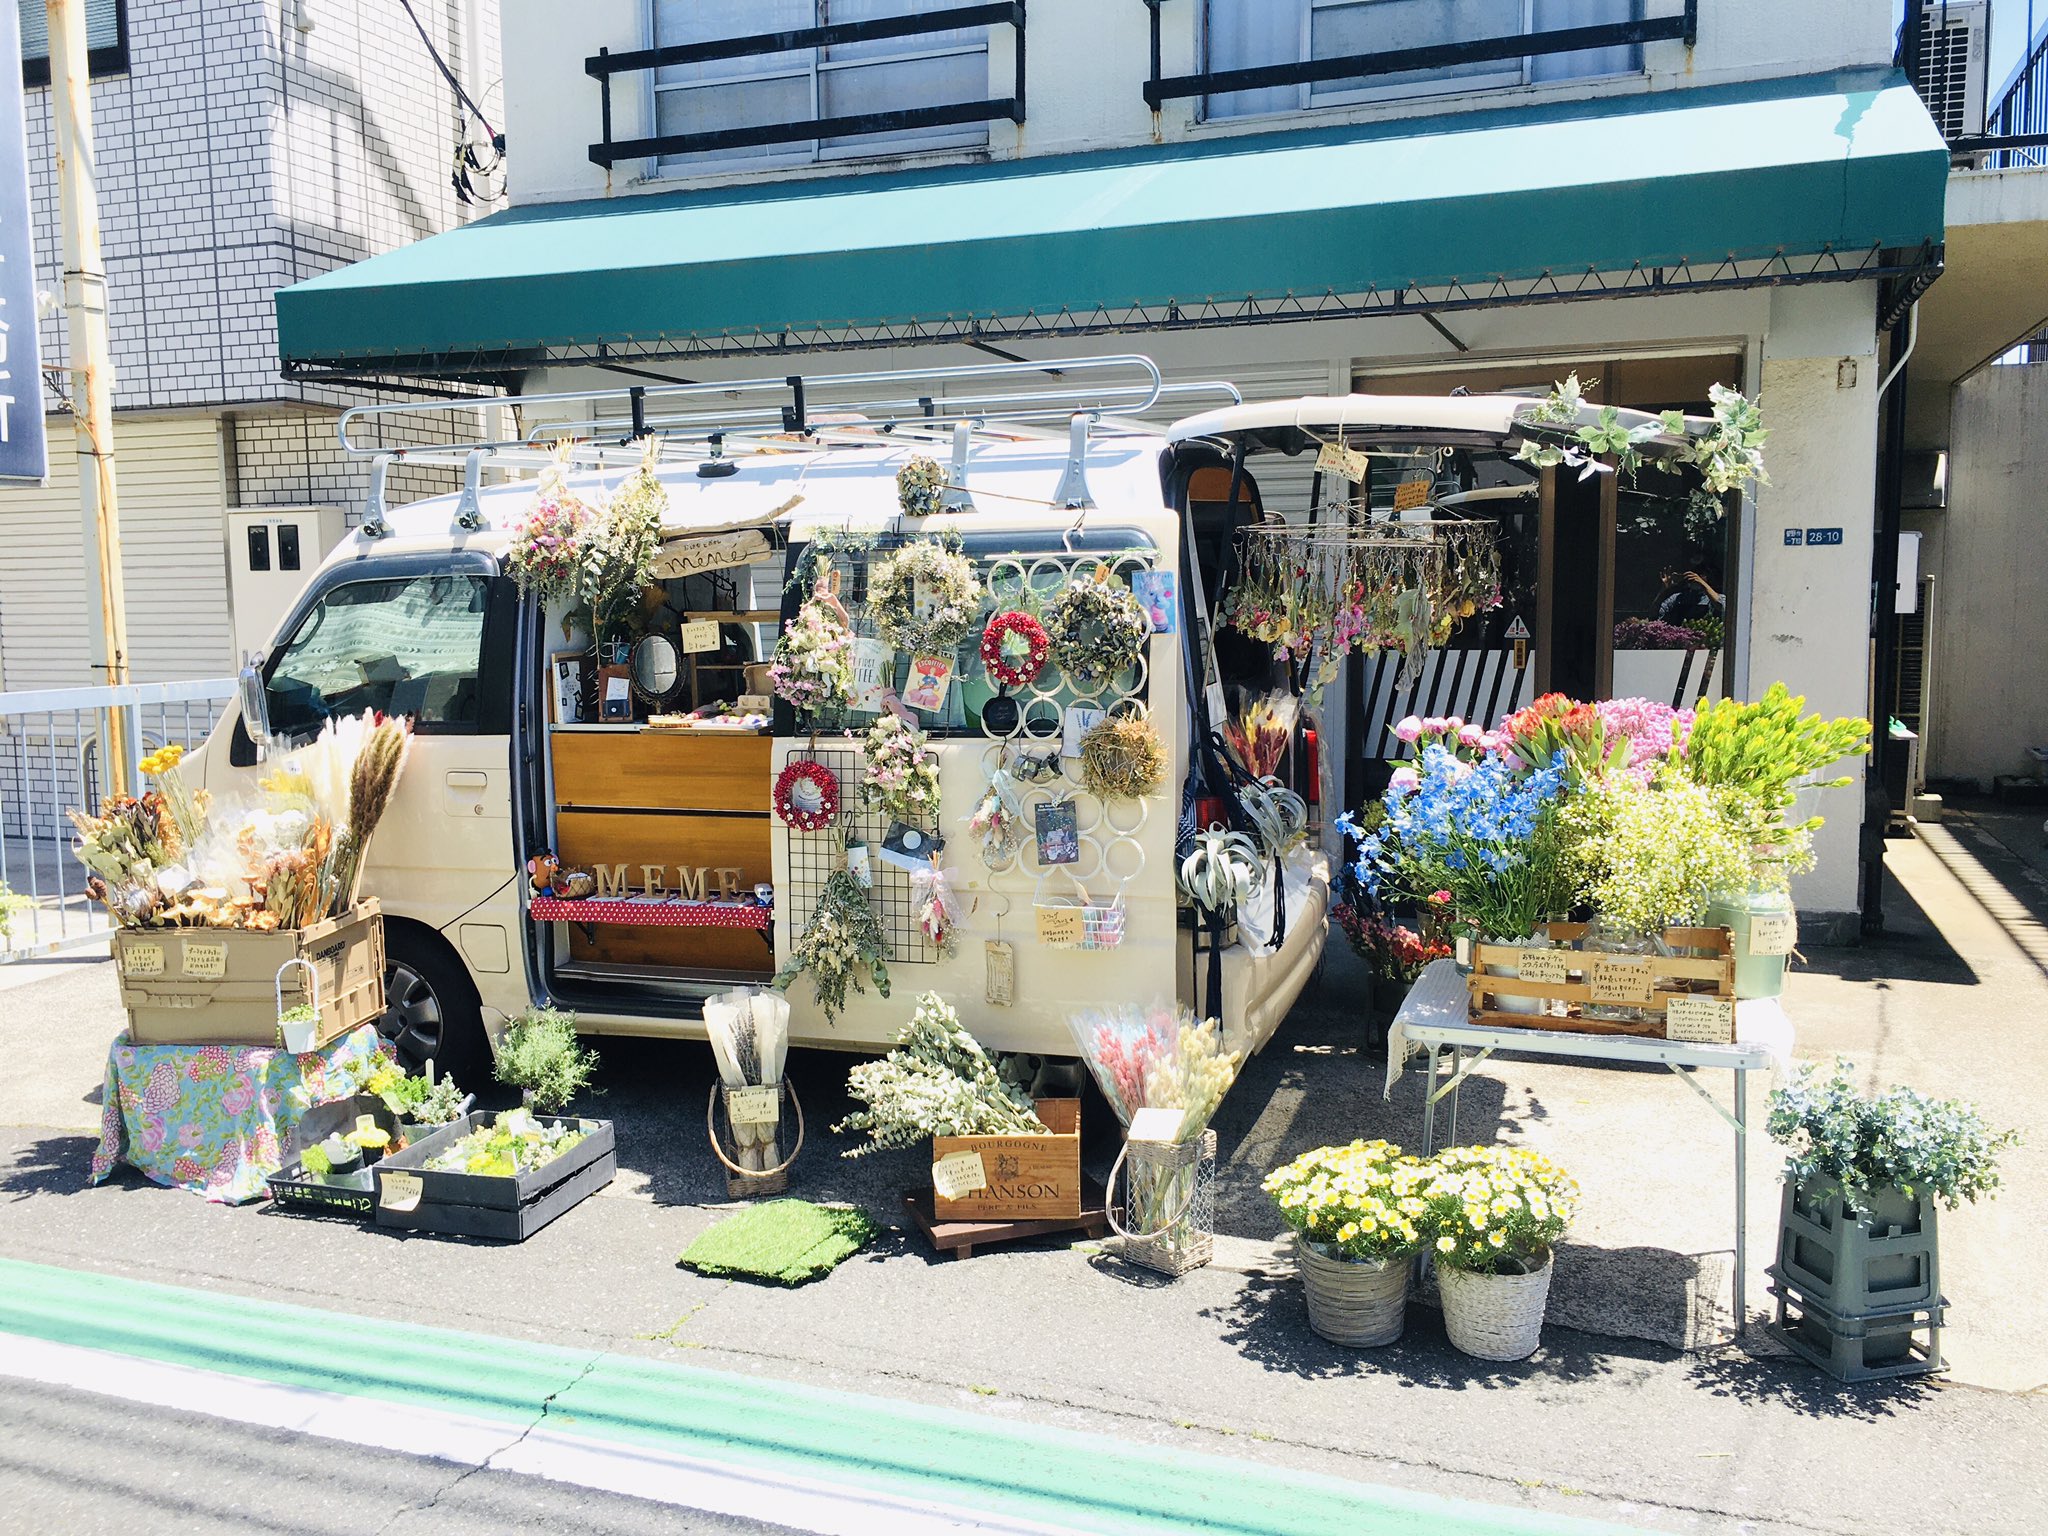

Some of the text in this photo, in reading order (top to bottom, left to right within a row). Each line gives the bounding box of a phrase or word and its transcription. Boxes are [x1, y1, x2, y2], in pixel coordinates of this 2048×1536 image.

[1809, 531, 1840, 542] 28-10
[592, 863, 746, 902] MEME
[970, 1140, 1048, 1152] BOURGOGNE
[968, 1184, 1059, 1201] HANSON
